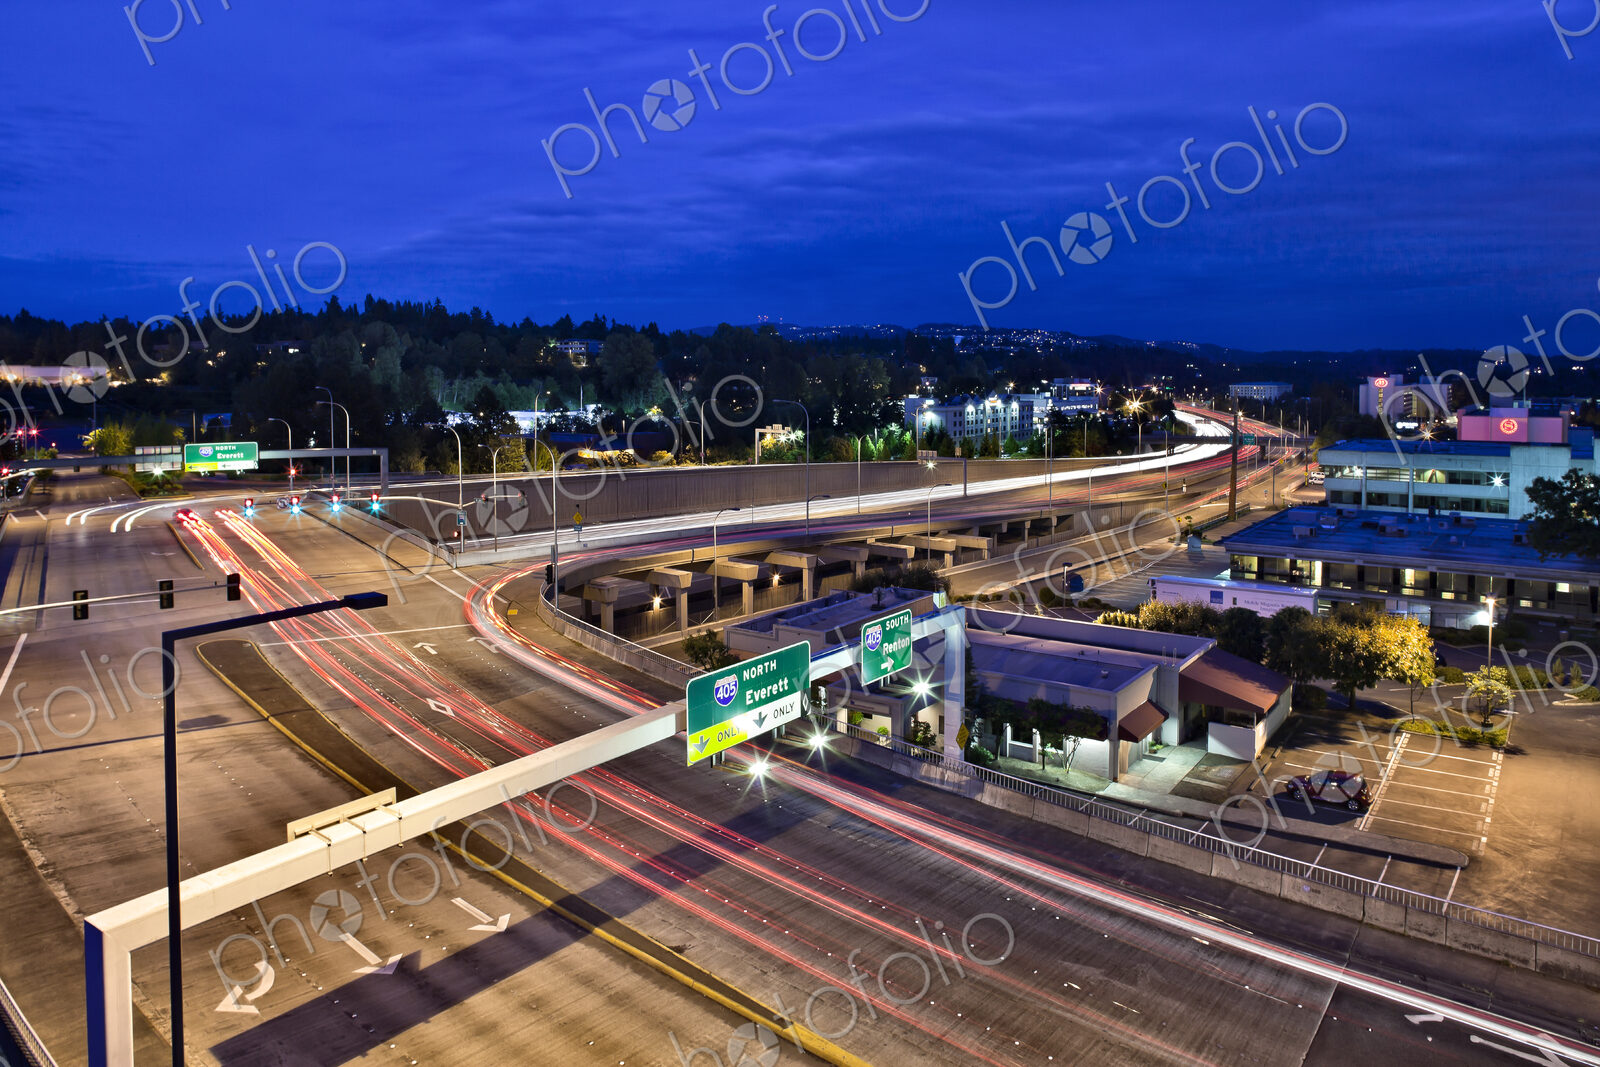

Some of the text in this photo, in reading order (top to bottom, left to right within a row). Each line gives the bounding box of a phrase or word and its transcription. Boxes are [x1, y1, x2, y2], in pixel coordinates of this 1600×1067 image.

[865, 631, 882, 649] 405
[885, 613, 909, 631] SOUTH
[883, 635, 911, 656] Renton
[715, 682, 737, 701] 405
[743, 658, 778, 682] NORTH
[745, 677, 789, 706] Everett
[773, 701, 795, 720] ONLY
